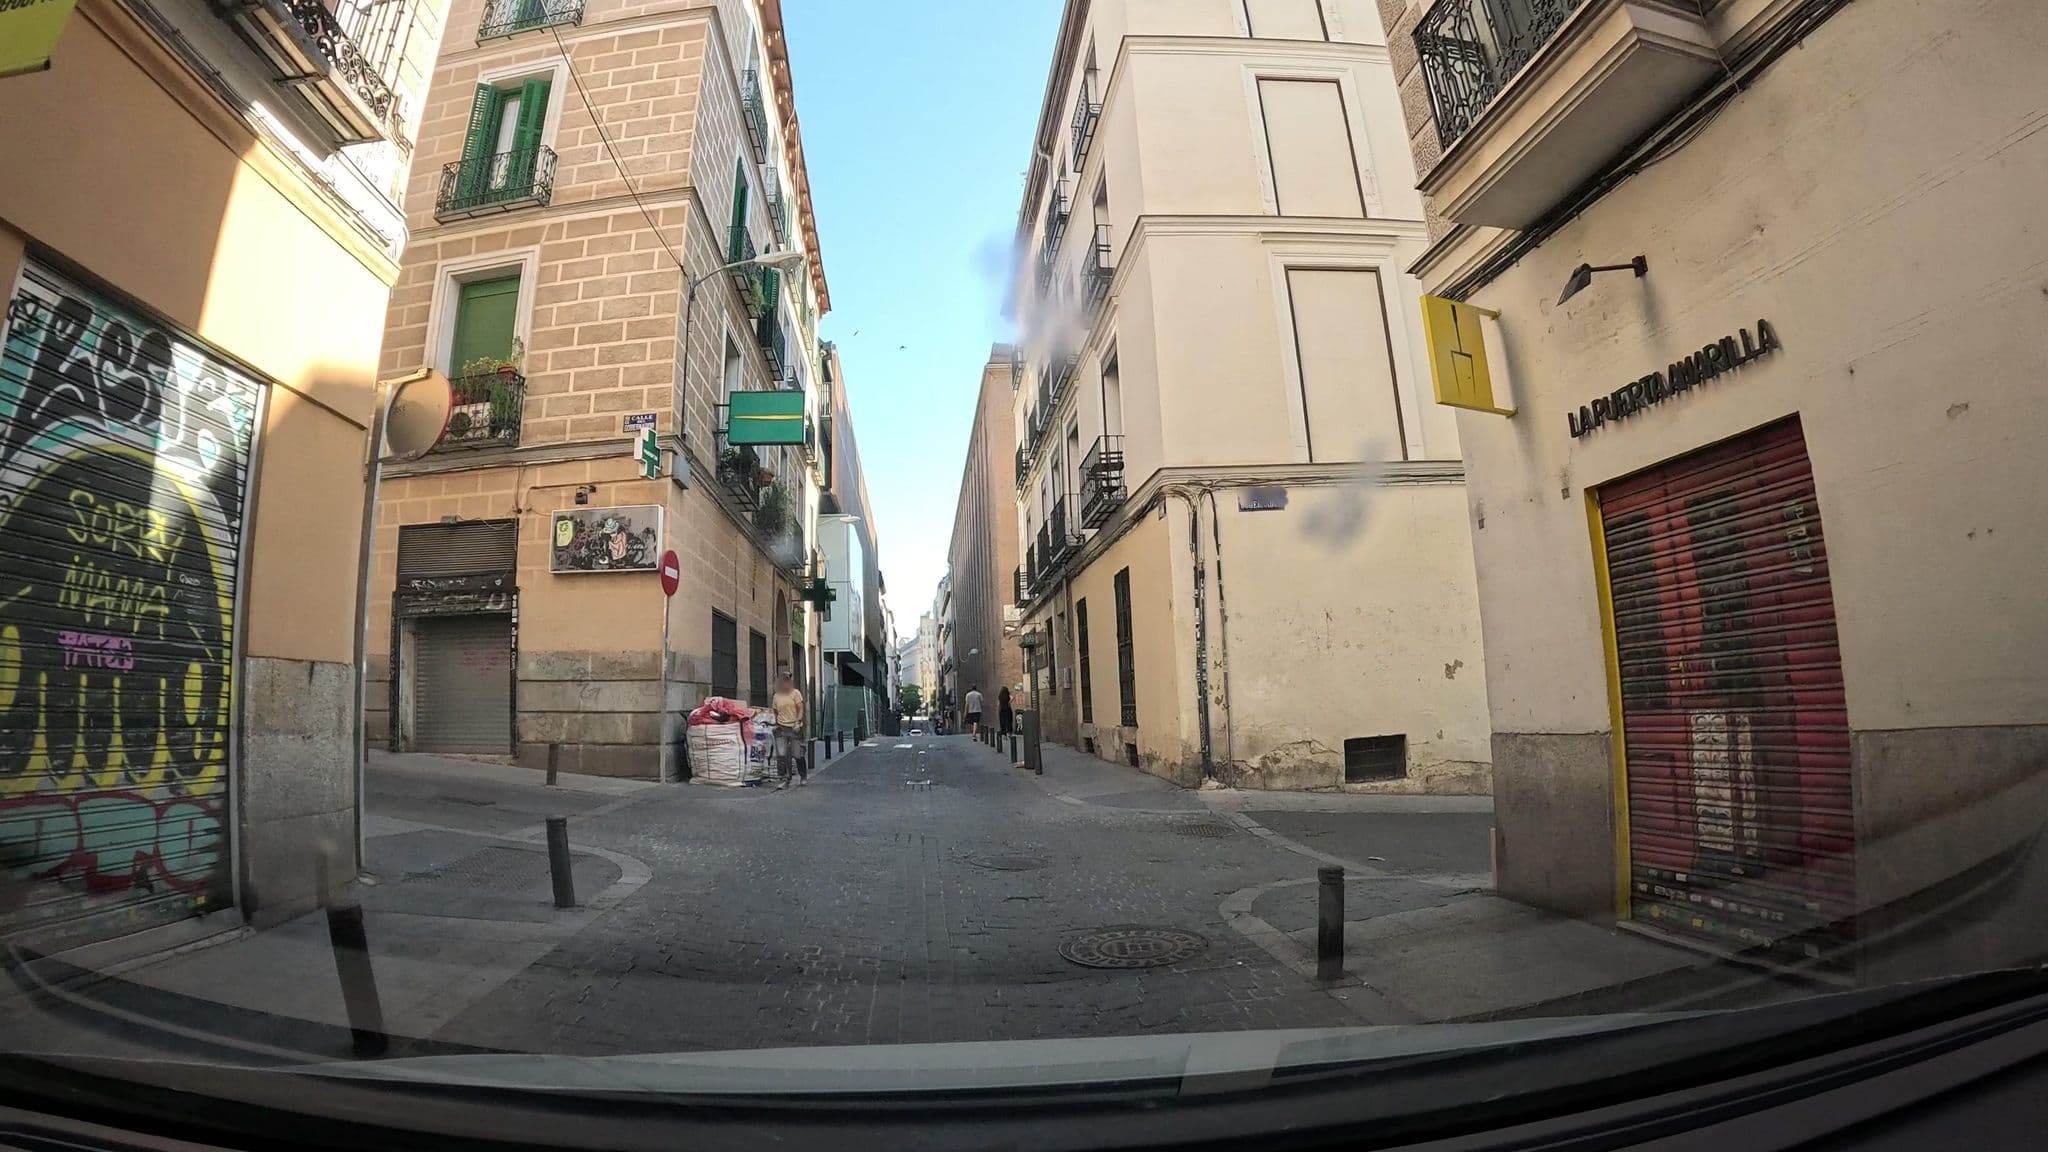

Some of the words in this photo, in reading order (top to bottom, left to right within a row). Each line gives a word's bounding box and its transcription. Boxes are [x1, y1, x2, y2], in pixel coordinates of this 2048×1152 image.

[1567, 405, 1591, 439] LA
[1590, 371, 1666, 428] PUERTA
[1667, 318, 1780, 395] AMARILLA
